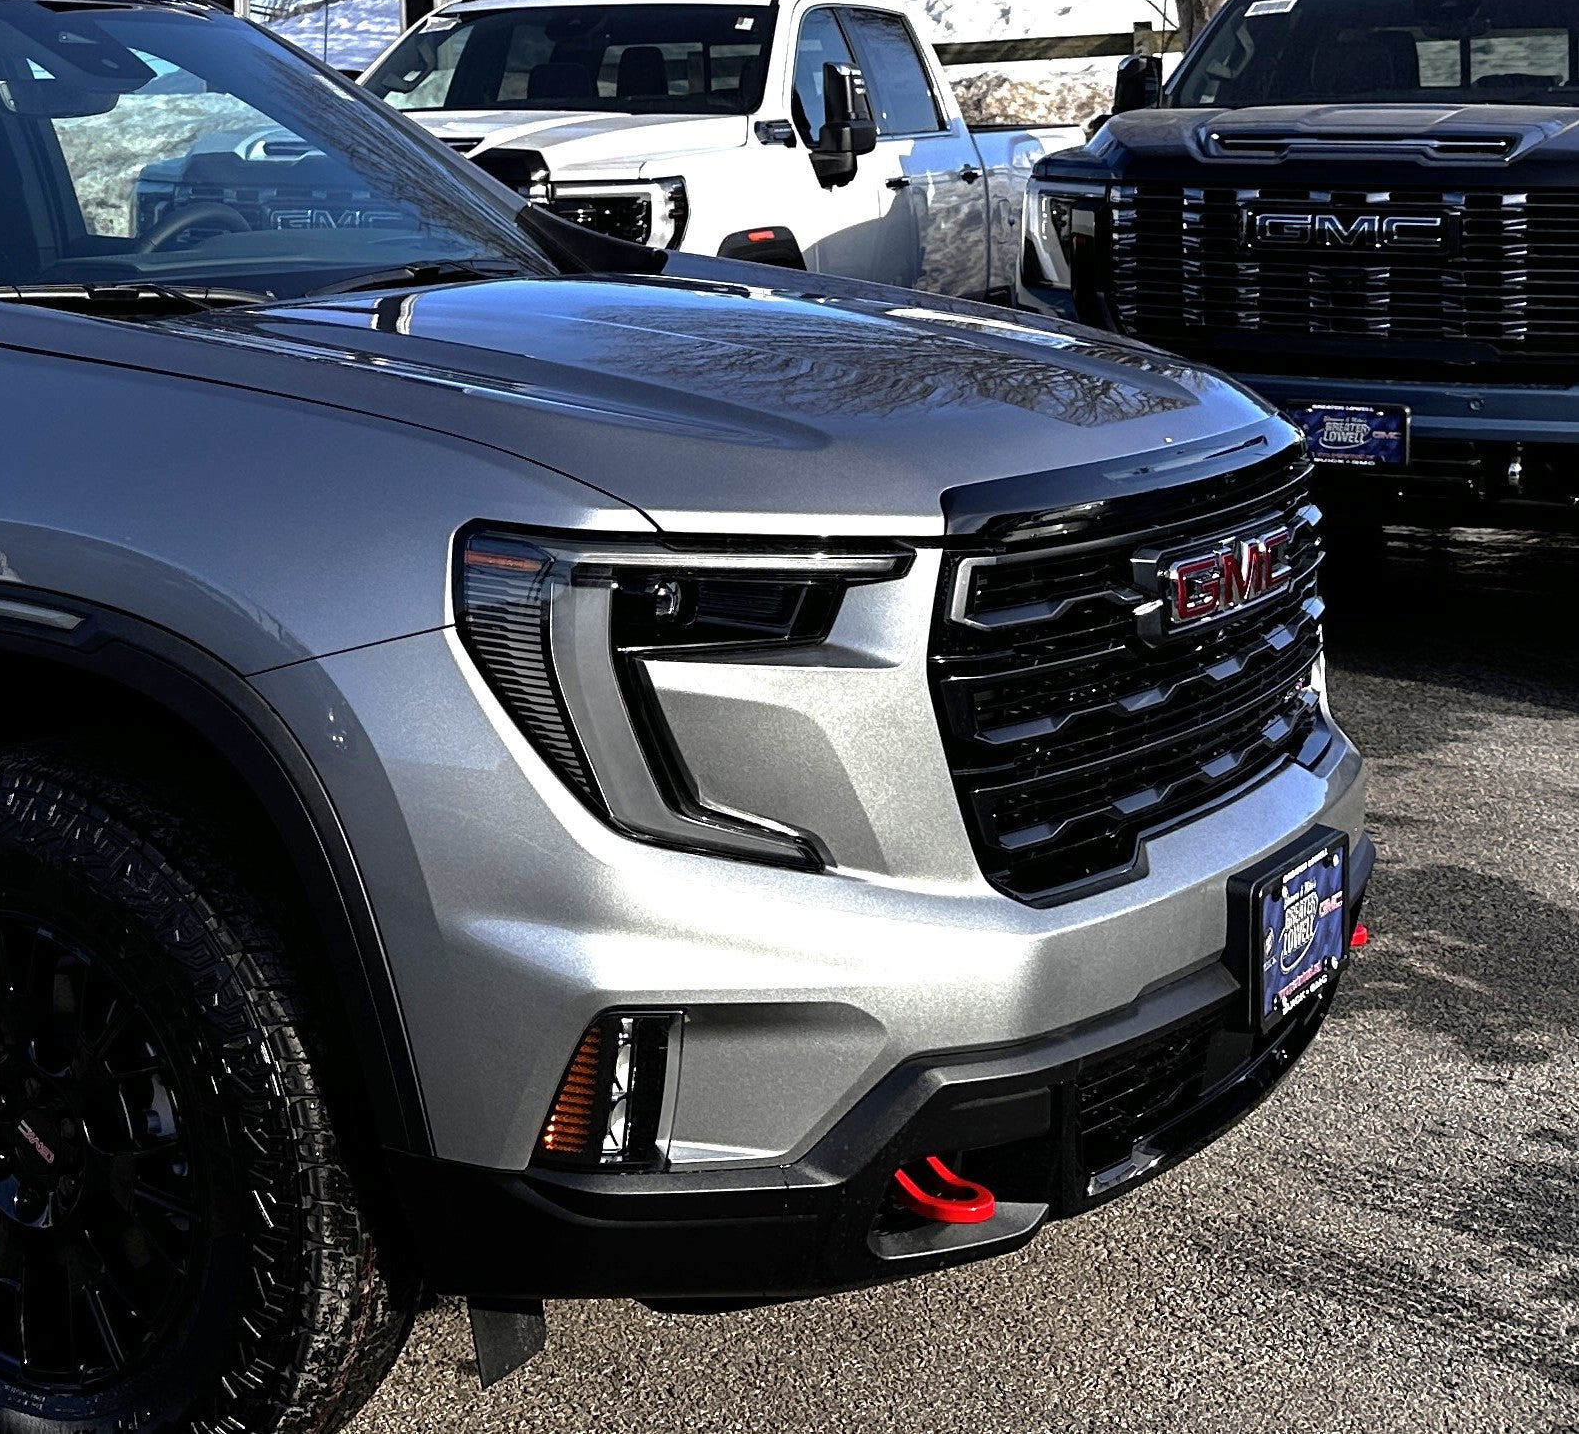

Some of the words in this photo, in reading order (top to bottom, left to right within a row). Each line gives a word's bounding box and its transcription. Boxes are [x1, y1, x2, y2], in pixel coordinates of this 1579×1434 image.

[1254, 214, 1442, 248] GMC
[1323, 431, 1364, 444] LOWELL
[1172, 526, 1292, 621] GMC
